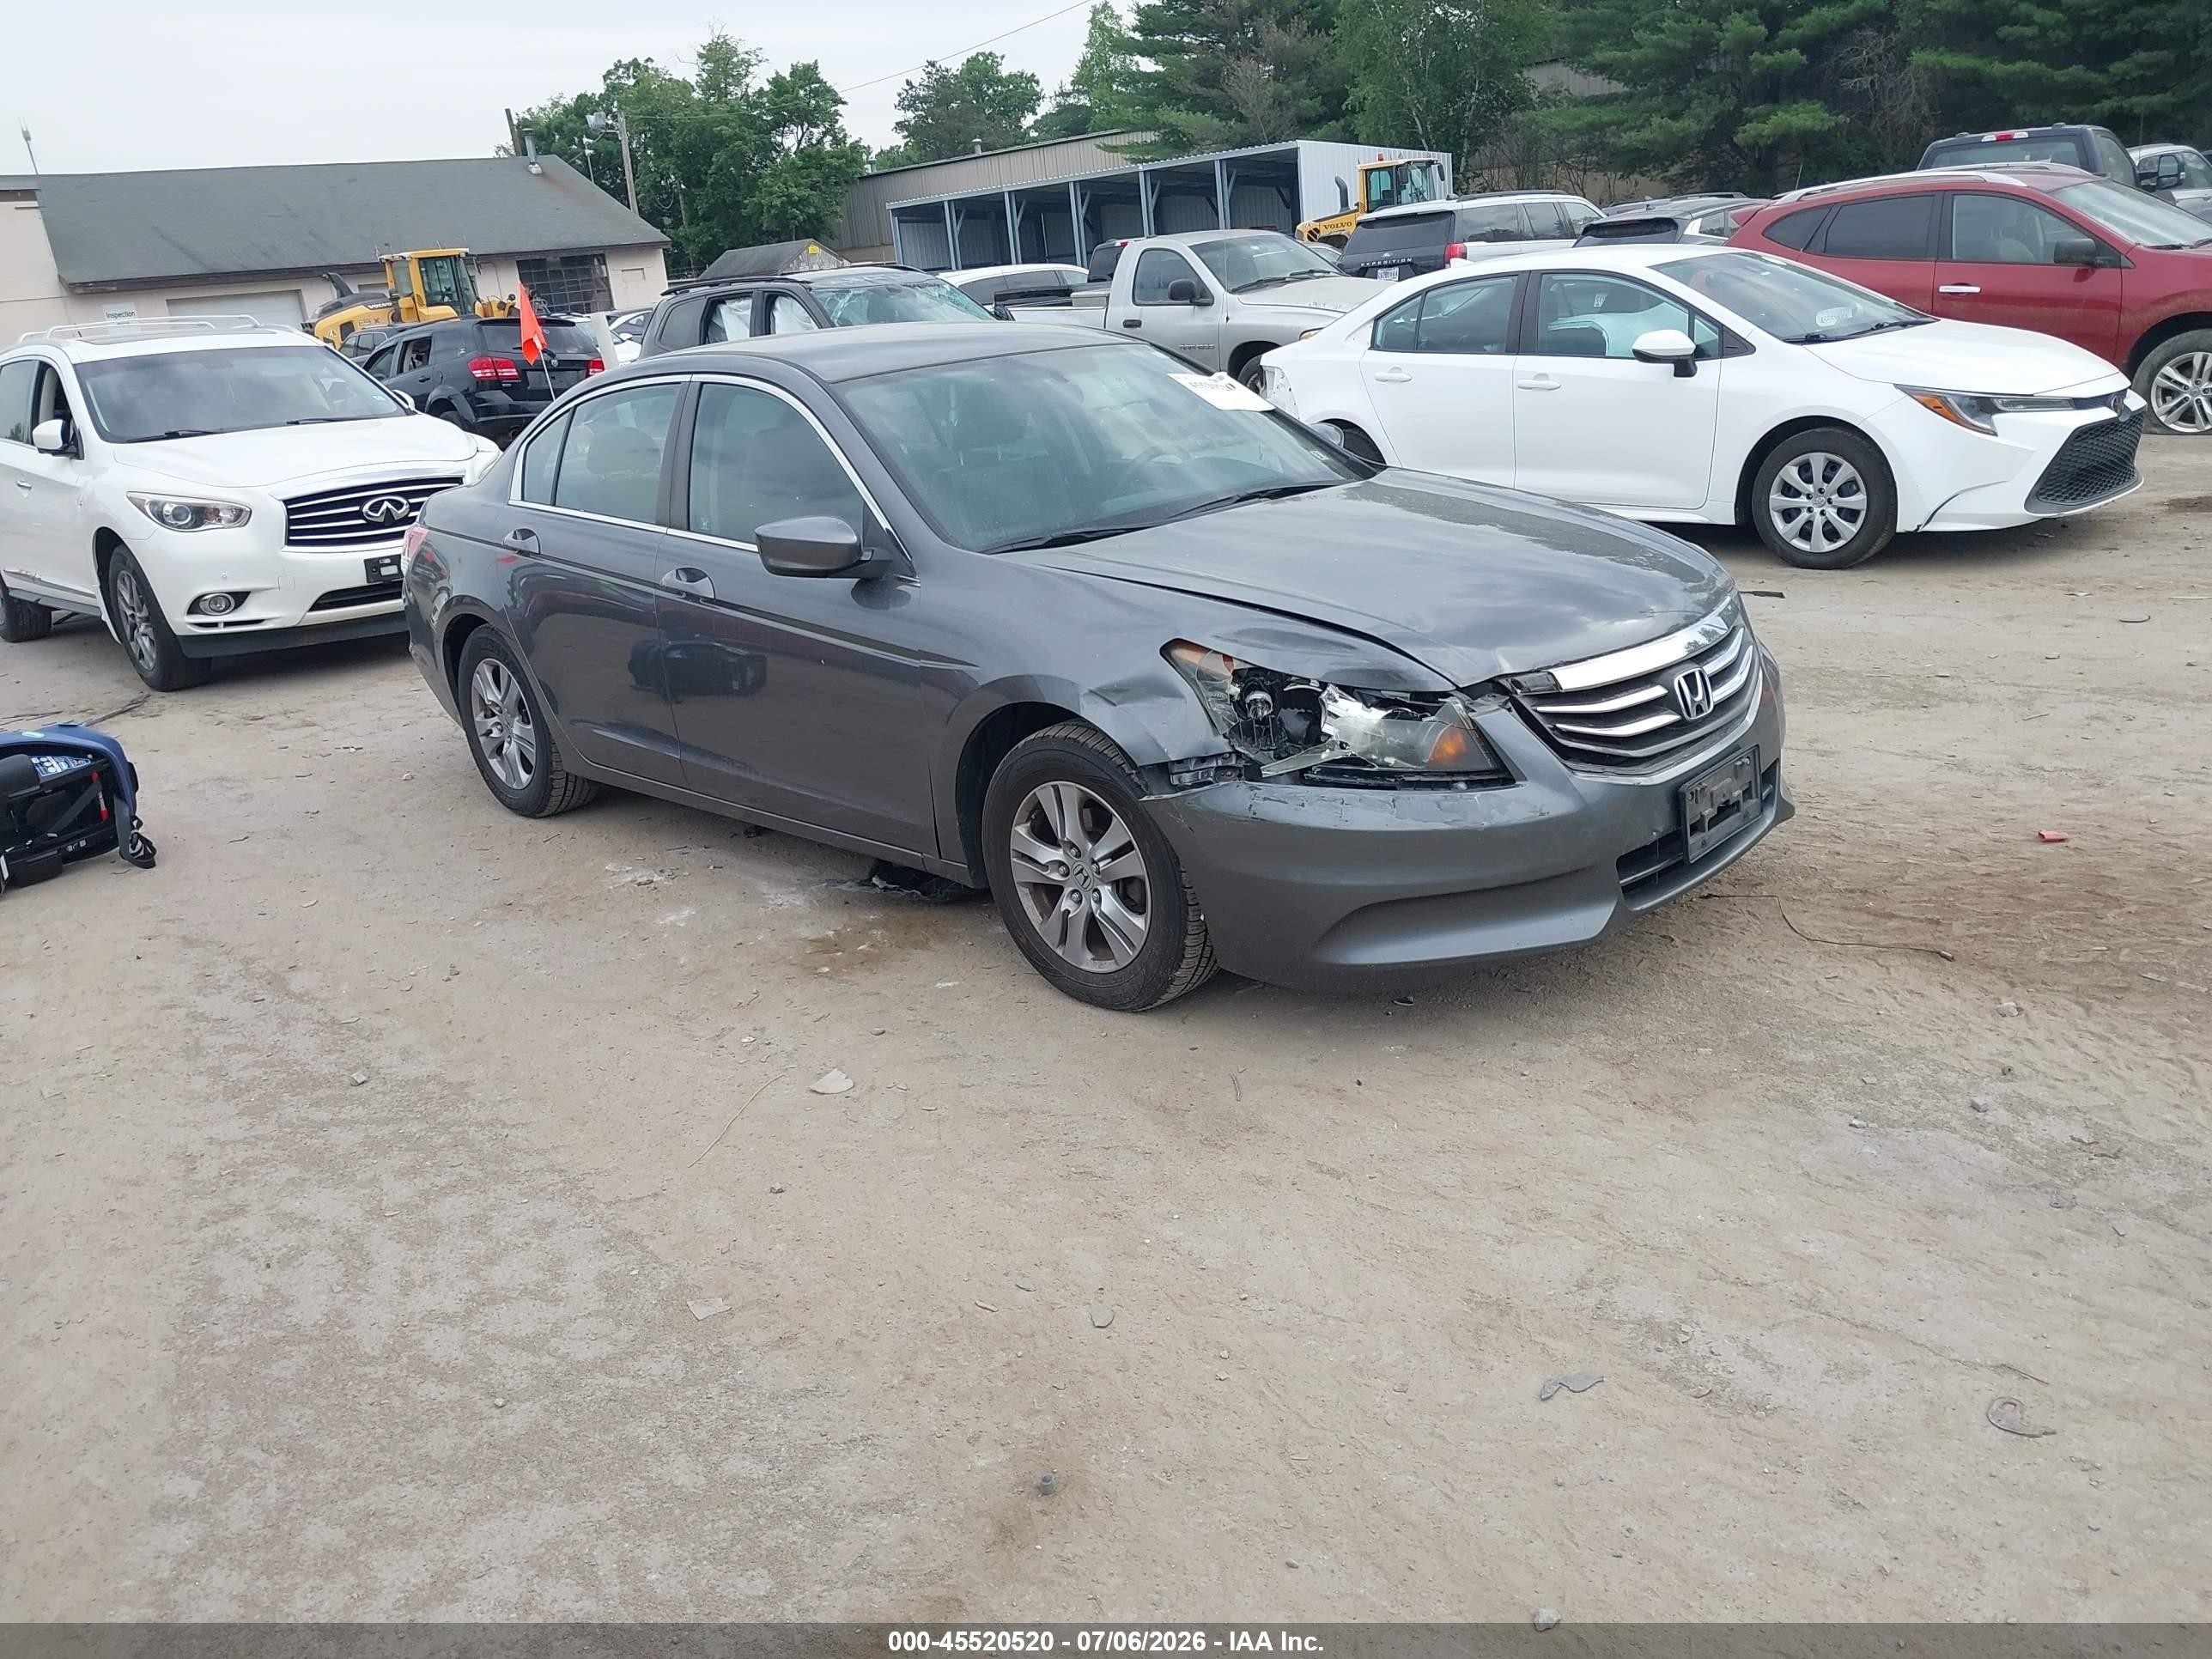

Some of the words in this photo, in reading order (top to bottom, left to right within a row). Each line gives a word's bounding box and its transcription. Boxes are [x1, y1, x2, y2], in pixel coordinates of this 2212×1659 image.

[1323, 222, 1352, 230] VOLVO
[1360, 258, 1413, 267] EXPEDITION
[106, 311, 136, 319] Inspection
